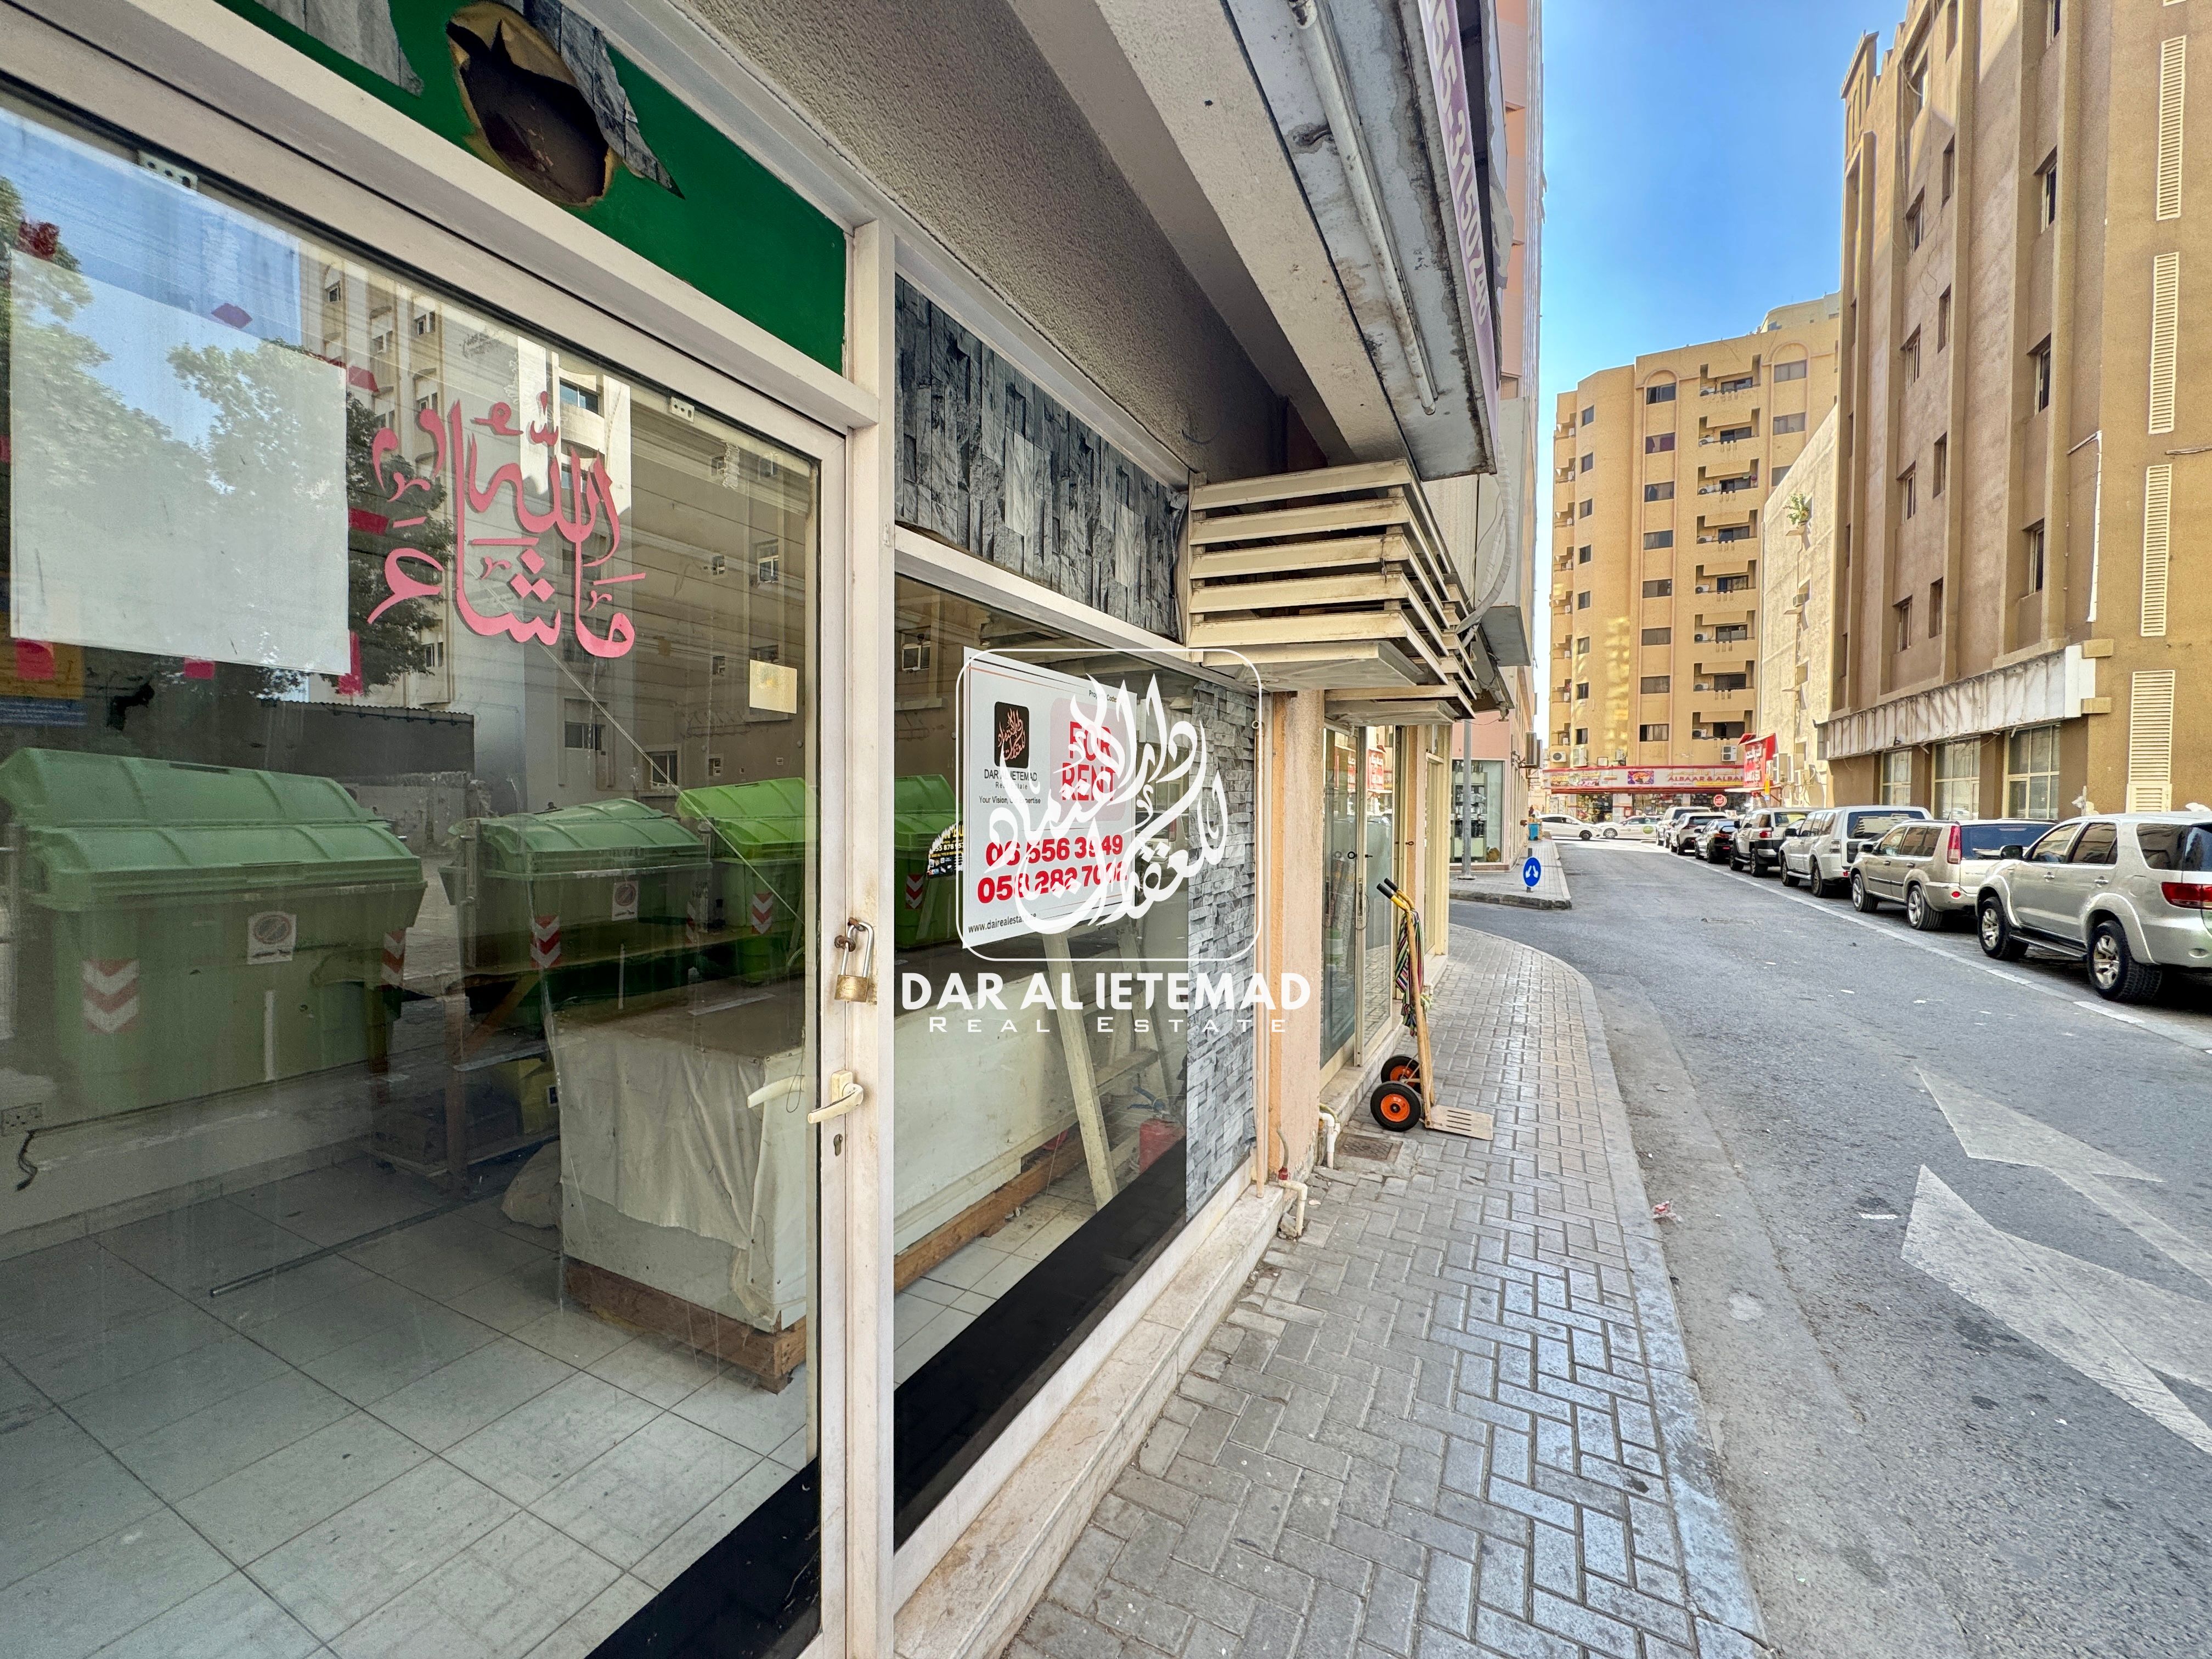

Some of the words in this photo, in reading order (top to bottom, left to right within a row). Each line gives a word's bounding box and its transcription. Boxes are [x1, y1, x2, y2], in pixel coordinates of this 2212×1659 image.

[1070, 721, 1111, 761] FOR
[984, 769, 999, 779] DAR
[1010, 770, 1037, 781] IETEMAD
[1062, 762, 1116, 801] RENT
[979, 795, 991, 804] Your
[992, 795, 1009, 805] Vision,
[986, 840, 1021, 867] 06
[1026, 838, 1070, 864] 556
[1035, 867, 1078, 895] 282
